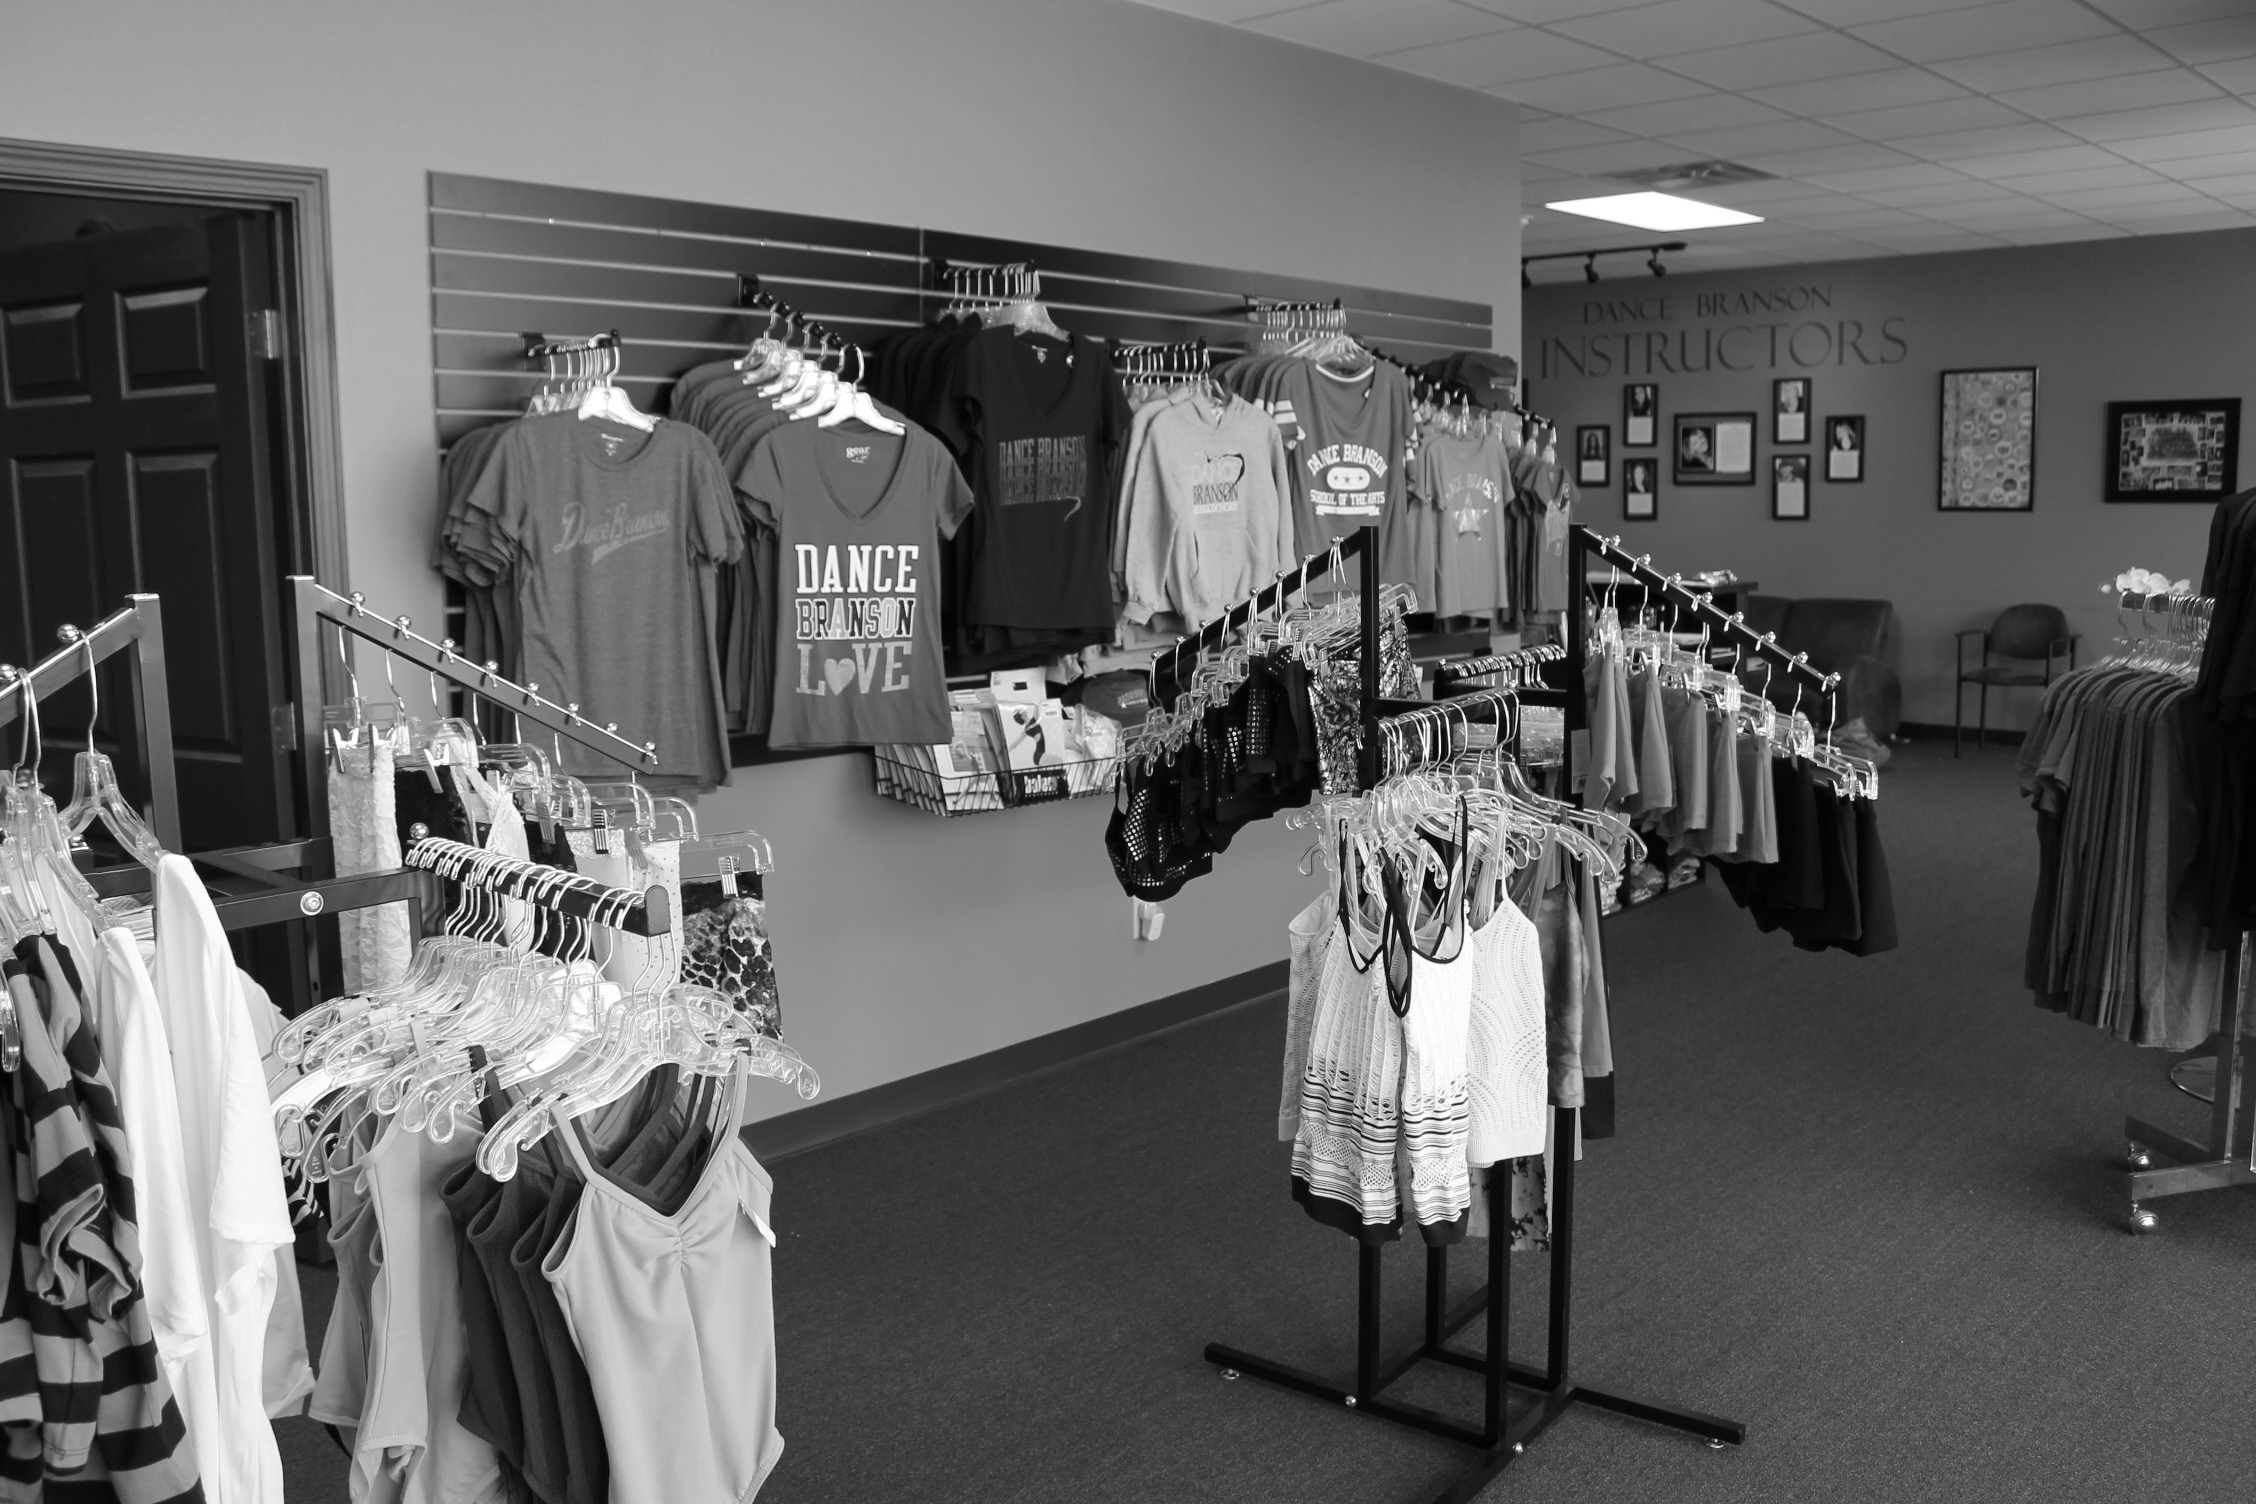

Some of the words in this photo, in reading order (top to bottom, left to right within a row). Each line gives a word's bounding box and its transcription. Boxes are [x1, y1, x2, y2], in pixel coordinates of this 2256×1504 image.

[1583, 297, 1671, 325] DANCE
[1696, 284, 1832, 317] BRANSON
[1540, 316, 1908, 379] INSTRUCTORS
[999, 437, 1034, 464] DANCE
[1037, 435, 1086, 462] BRANSON
[1306, 444, 1340, 477] DANCE
[1343, 443, 1388, 479] BRANSON
[1192, 482, 1239, 505] BRANSON
[1310, 489, 1337, 506] SCHOOL
[1338, 493, 1348, 506] OF
[1350, 492, 1367, 506] THE
[1367, 490, 1386, 505] ARTS
[795, 543, 920, 594] DANCE
[795, 597, 916, 640] BRANSON
